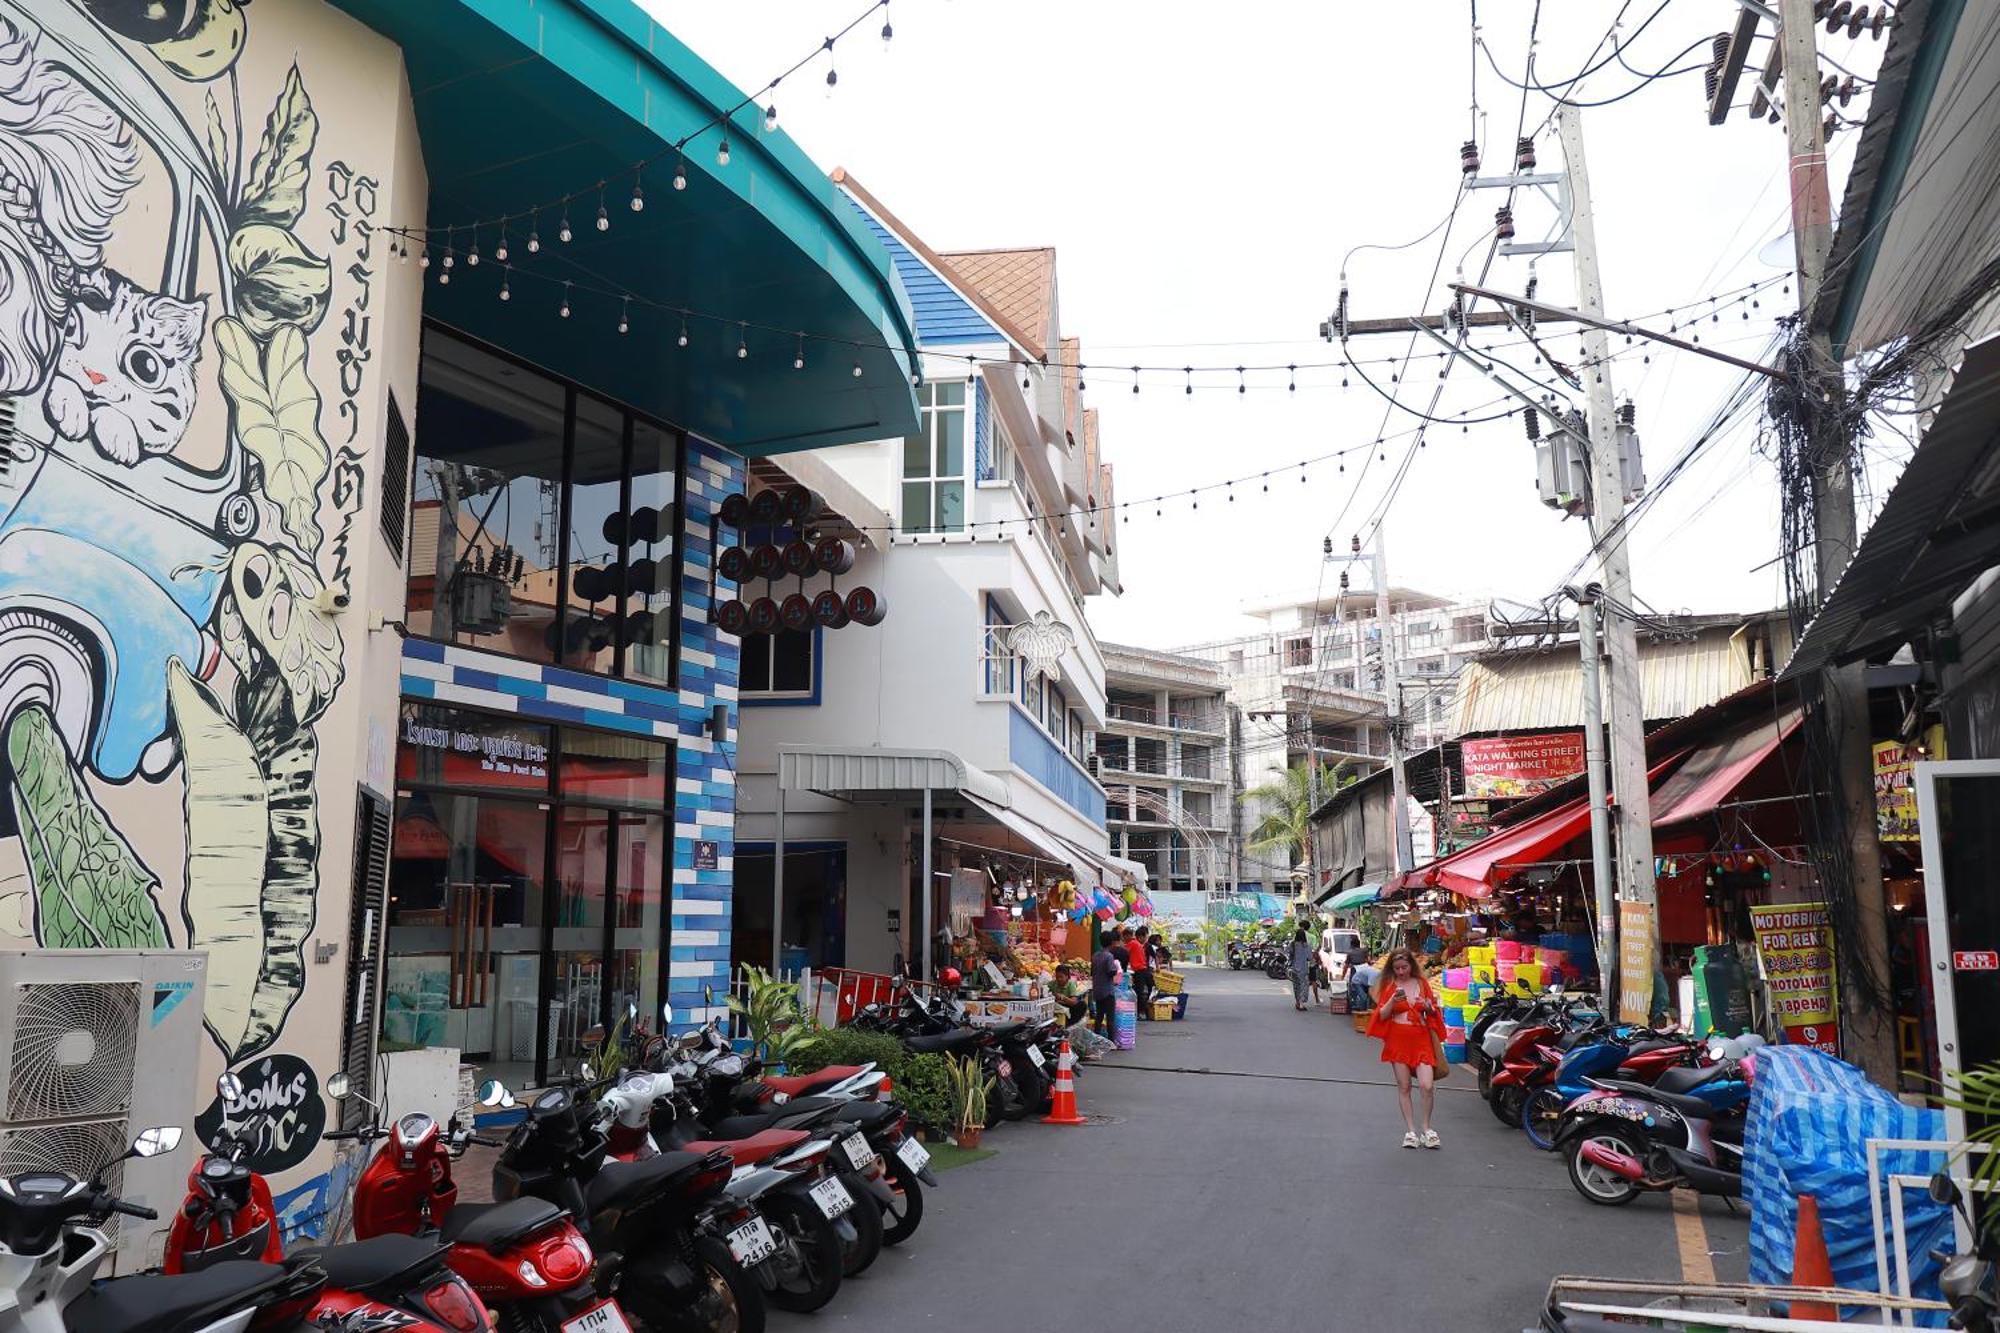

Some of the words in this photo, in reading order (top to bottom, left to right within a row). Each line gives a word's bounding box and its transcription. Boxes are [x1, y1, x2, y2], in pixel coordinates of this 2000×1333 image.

[1464, 752, 1489, 763] KATA
[1490, 749, 1539, 761] WALKING
[1541, 746, 1580, 758] STREET
[1474, 762, 1503, 773] NIGHT
[1505, 759, 1547, 770] MARKET
[1762, 934, 1788, 949] FOR
[1791, 931, 1826, 947] RENT
[155, 981, 194, 990] DAIKIN
[1785, 997, 1830, 1015] аренду
[827, 1198, 850, 1216] 9515
[743, 1241, 773, 1266] 2416
